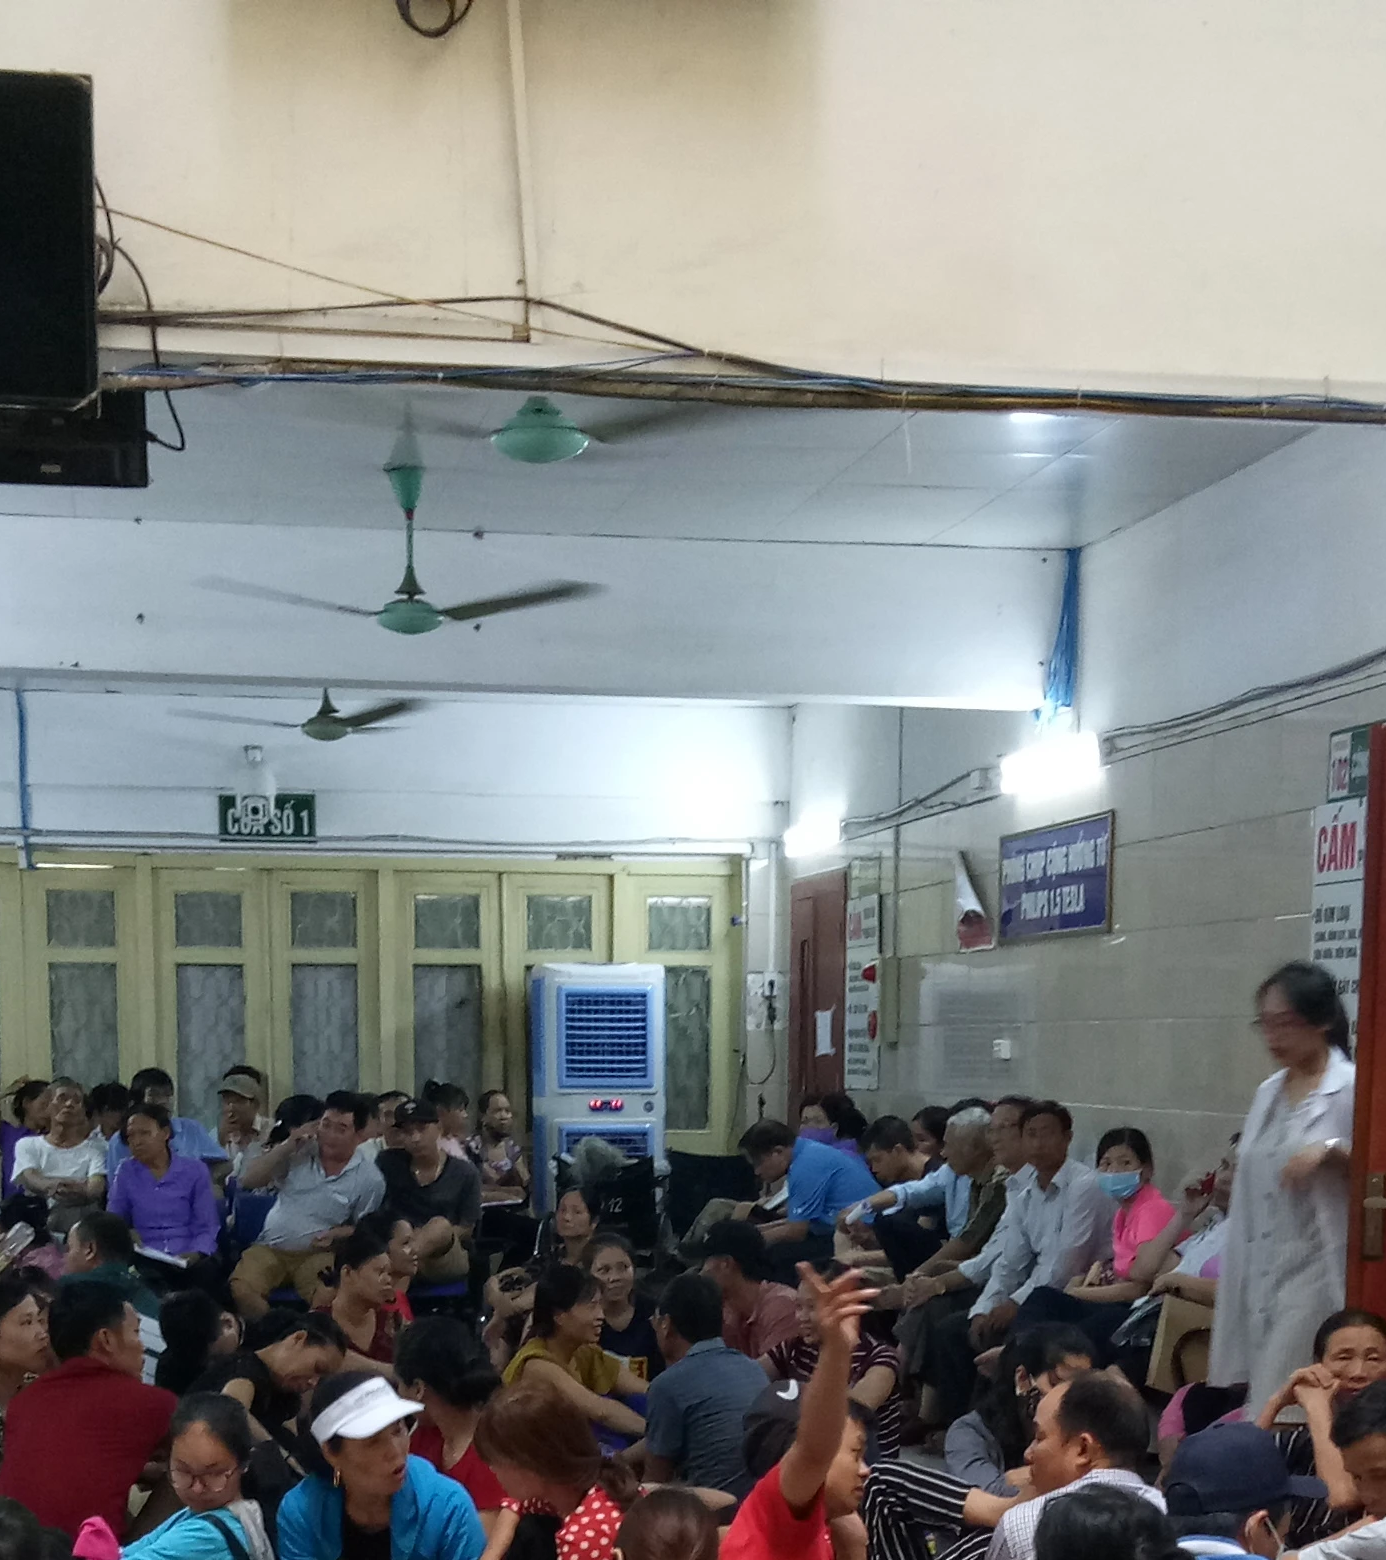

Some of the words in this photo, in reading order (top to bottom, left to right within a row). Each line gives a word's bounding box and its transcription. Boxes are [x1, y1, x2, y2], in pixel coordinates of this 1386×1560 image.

[270, 800, 295, 835] SỐ
[300, 809, 309, 835] 1
[1317, 805, 1357, 873] CẤM
[608, 1197, 622, 1212] 12
